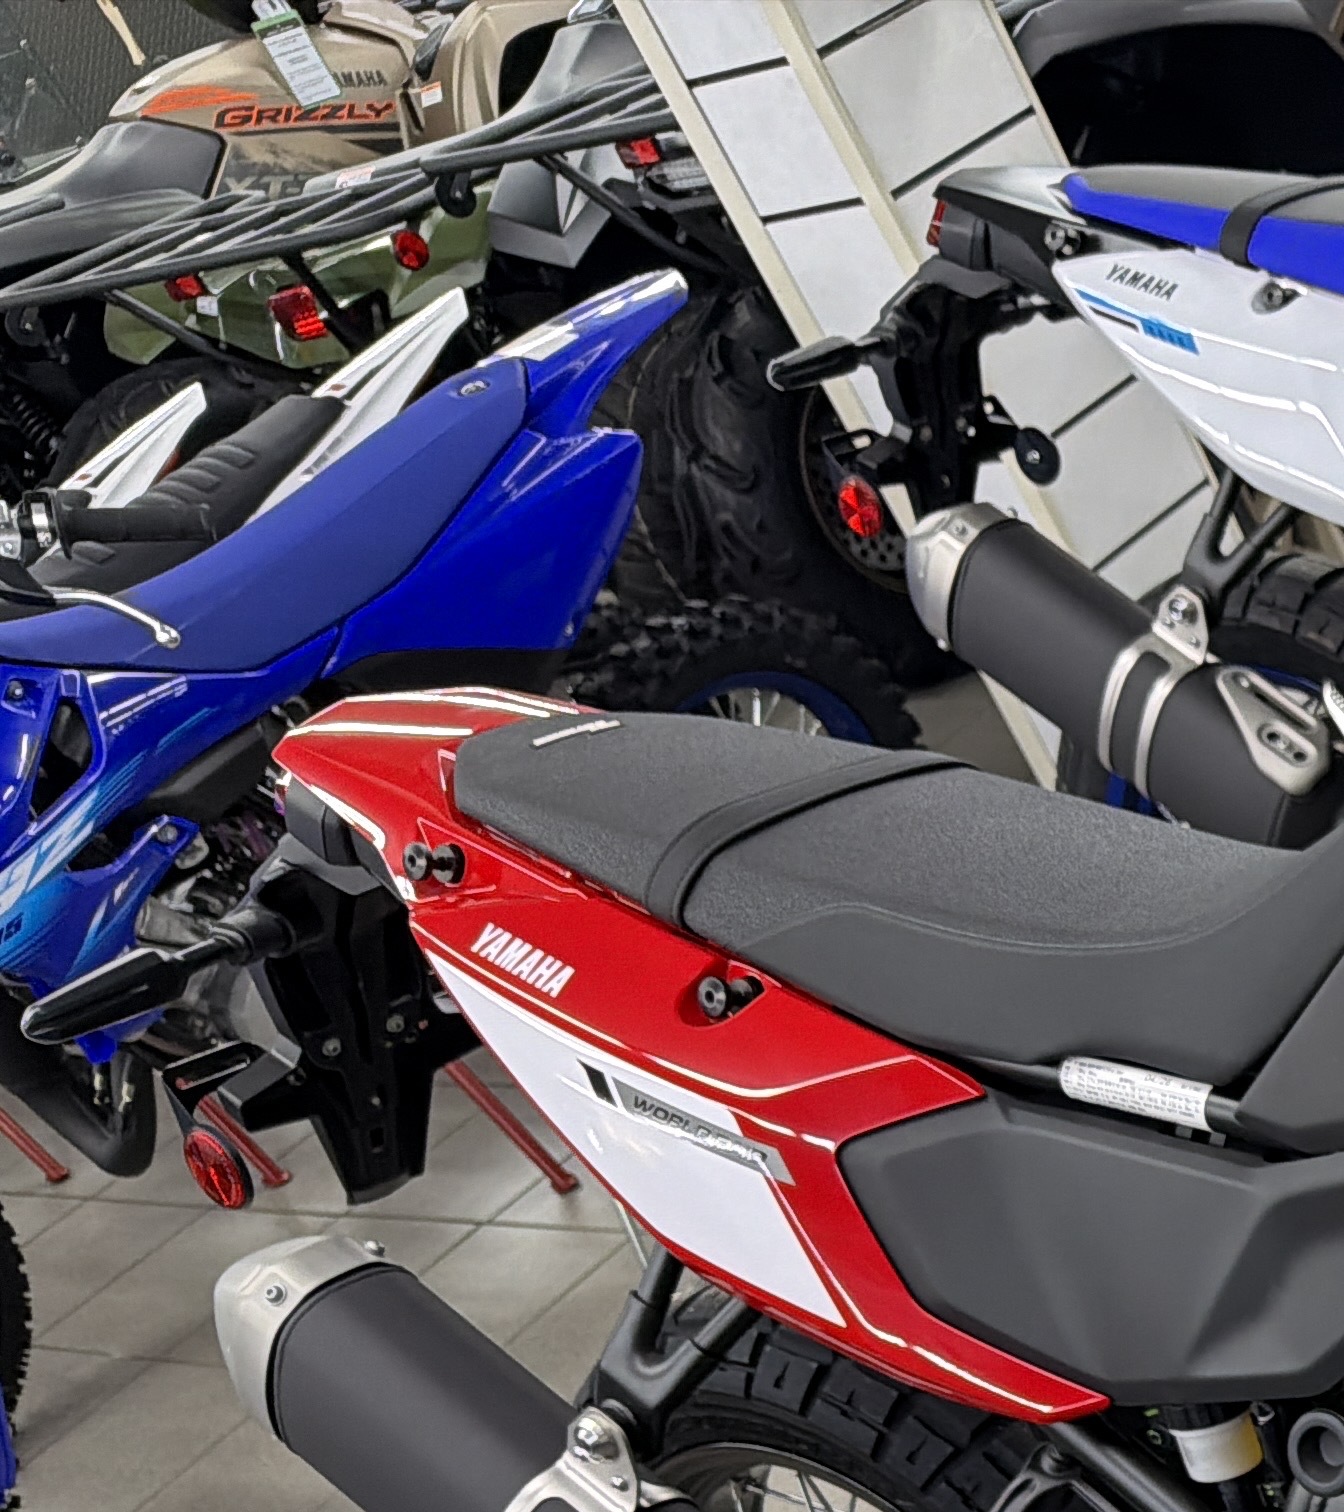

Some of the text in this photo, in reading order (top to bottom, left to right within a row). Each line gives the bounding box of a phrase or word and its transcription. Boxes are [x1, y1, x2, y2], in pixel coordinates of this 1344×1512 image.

[214, 102, 396, 129] GRIZZLY
[1105, 264, 1179, 301] YAMAHA
[470, 922, 576, 998] YAMAHA
